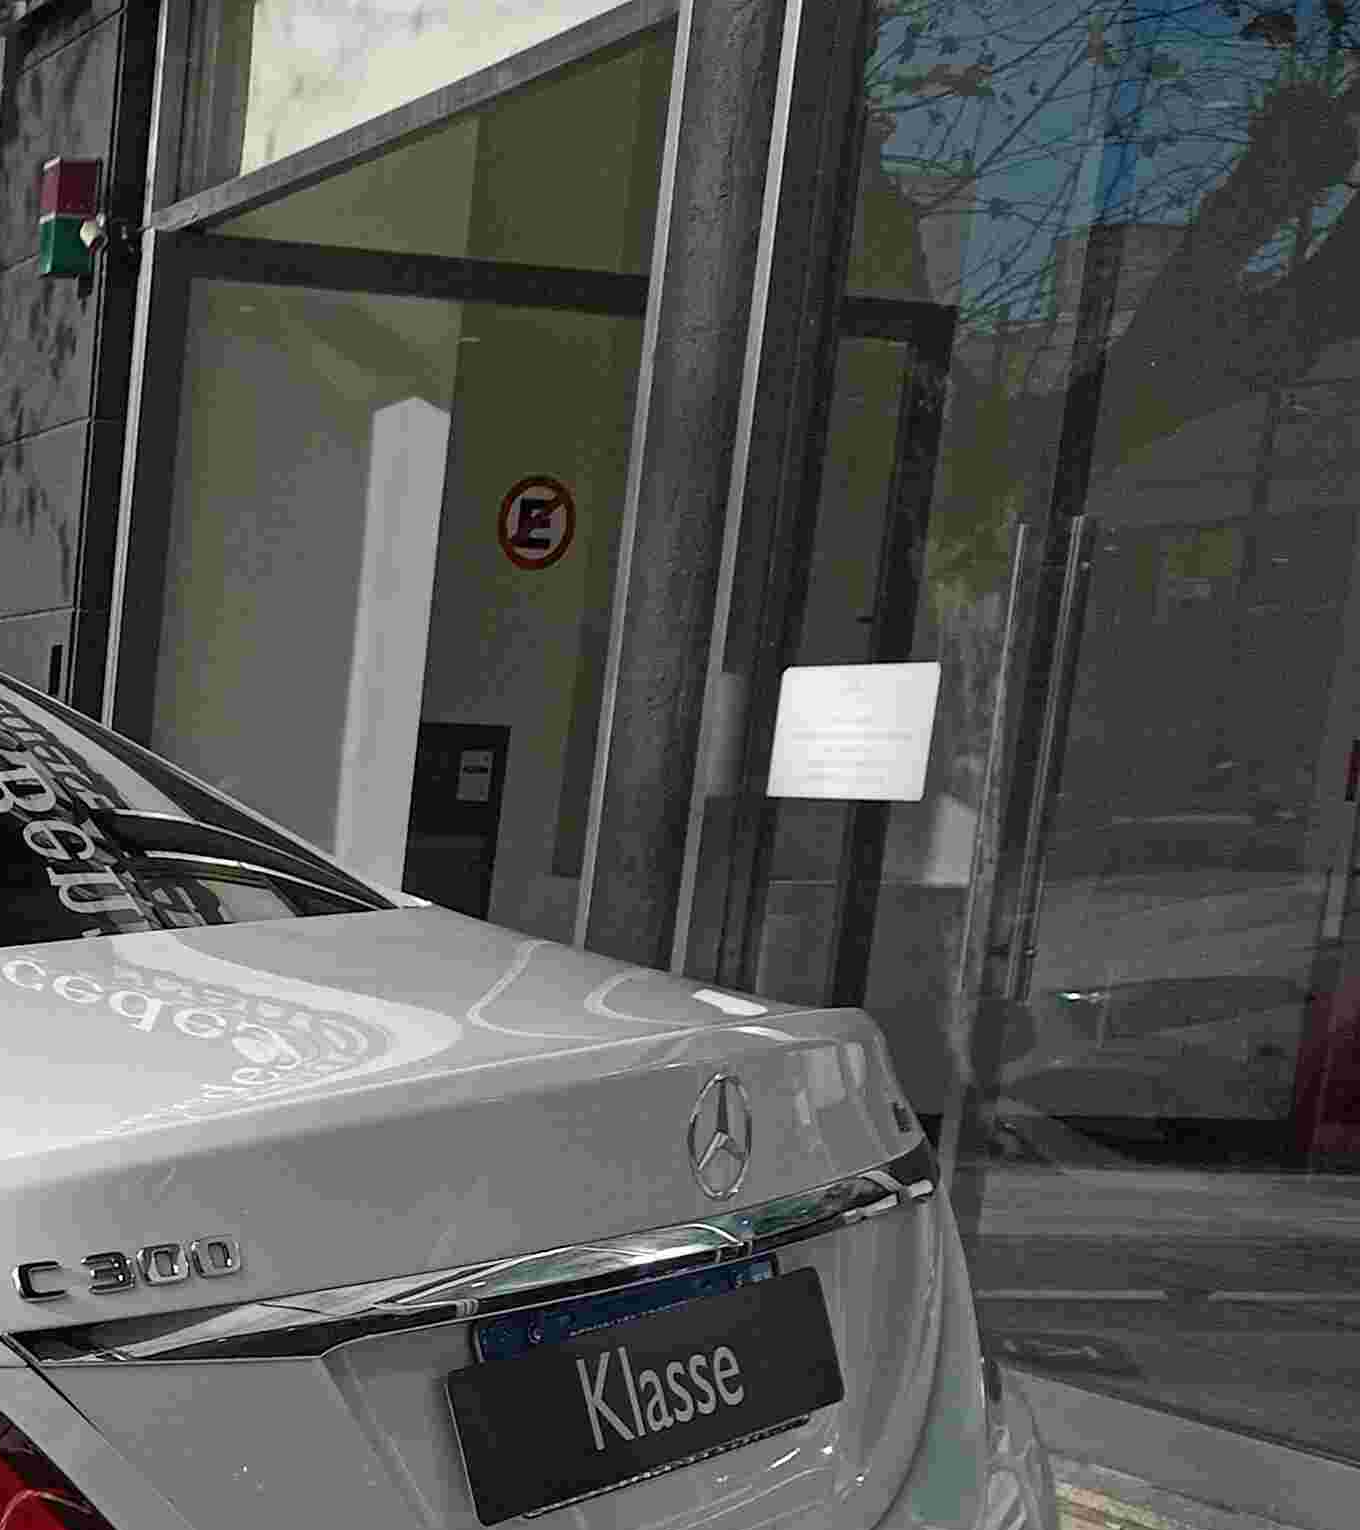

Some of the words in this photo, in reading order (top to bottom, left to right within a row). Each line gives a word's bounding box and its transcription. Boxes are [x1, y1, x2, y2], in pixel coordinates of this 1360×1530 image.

[12, 1259, 68, 1302] C
[81, 1235, 241, 1295] 300
[575, 1346, 745, 1451] Klasse
